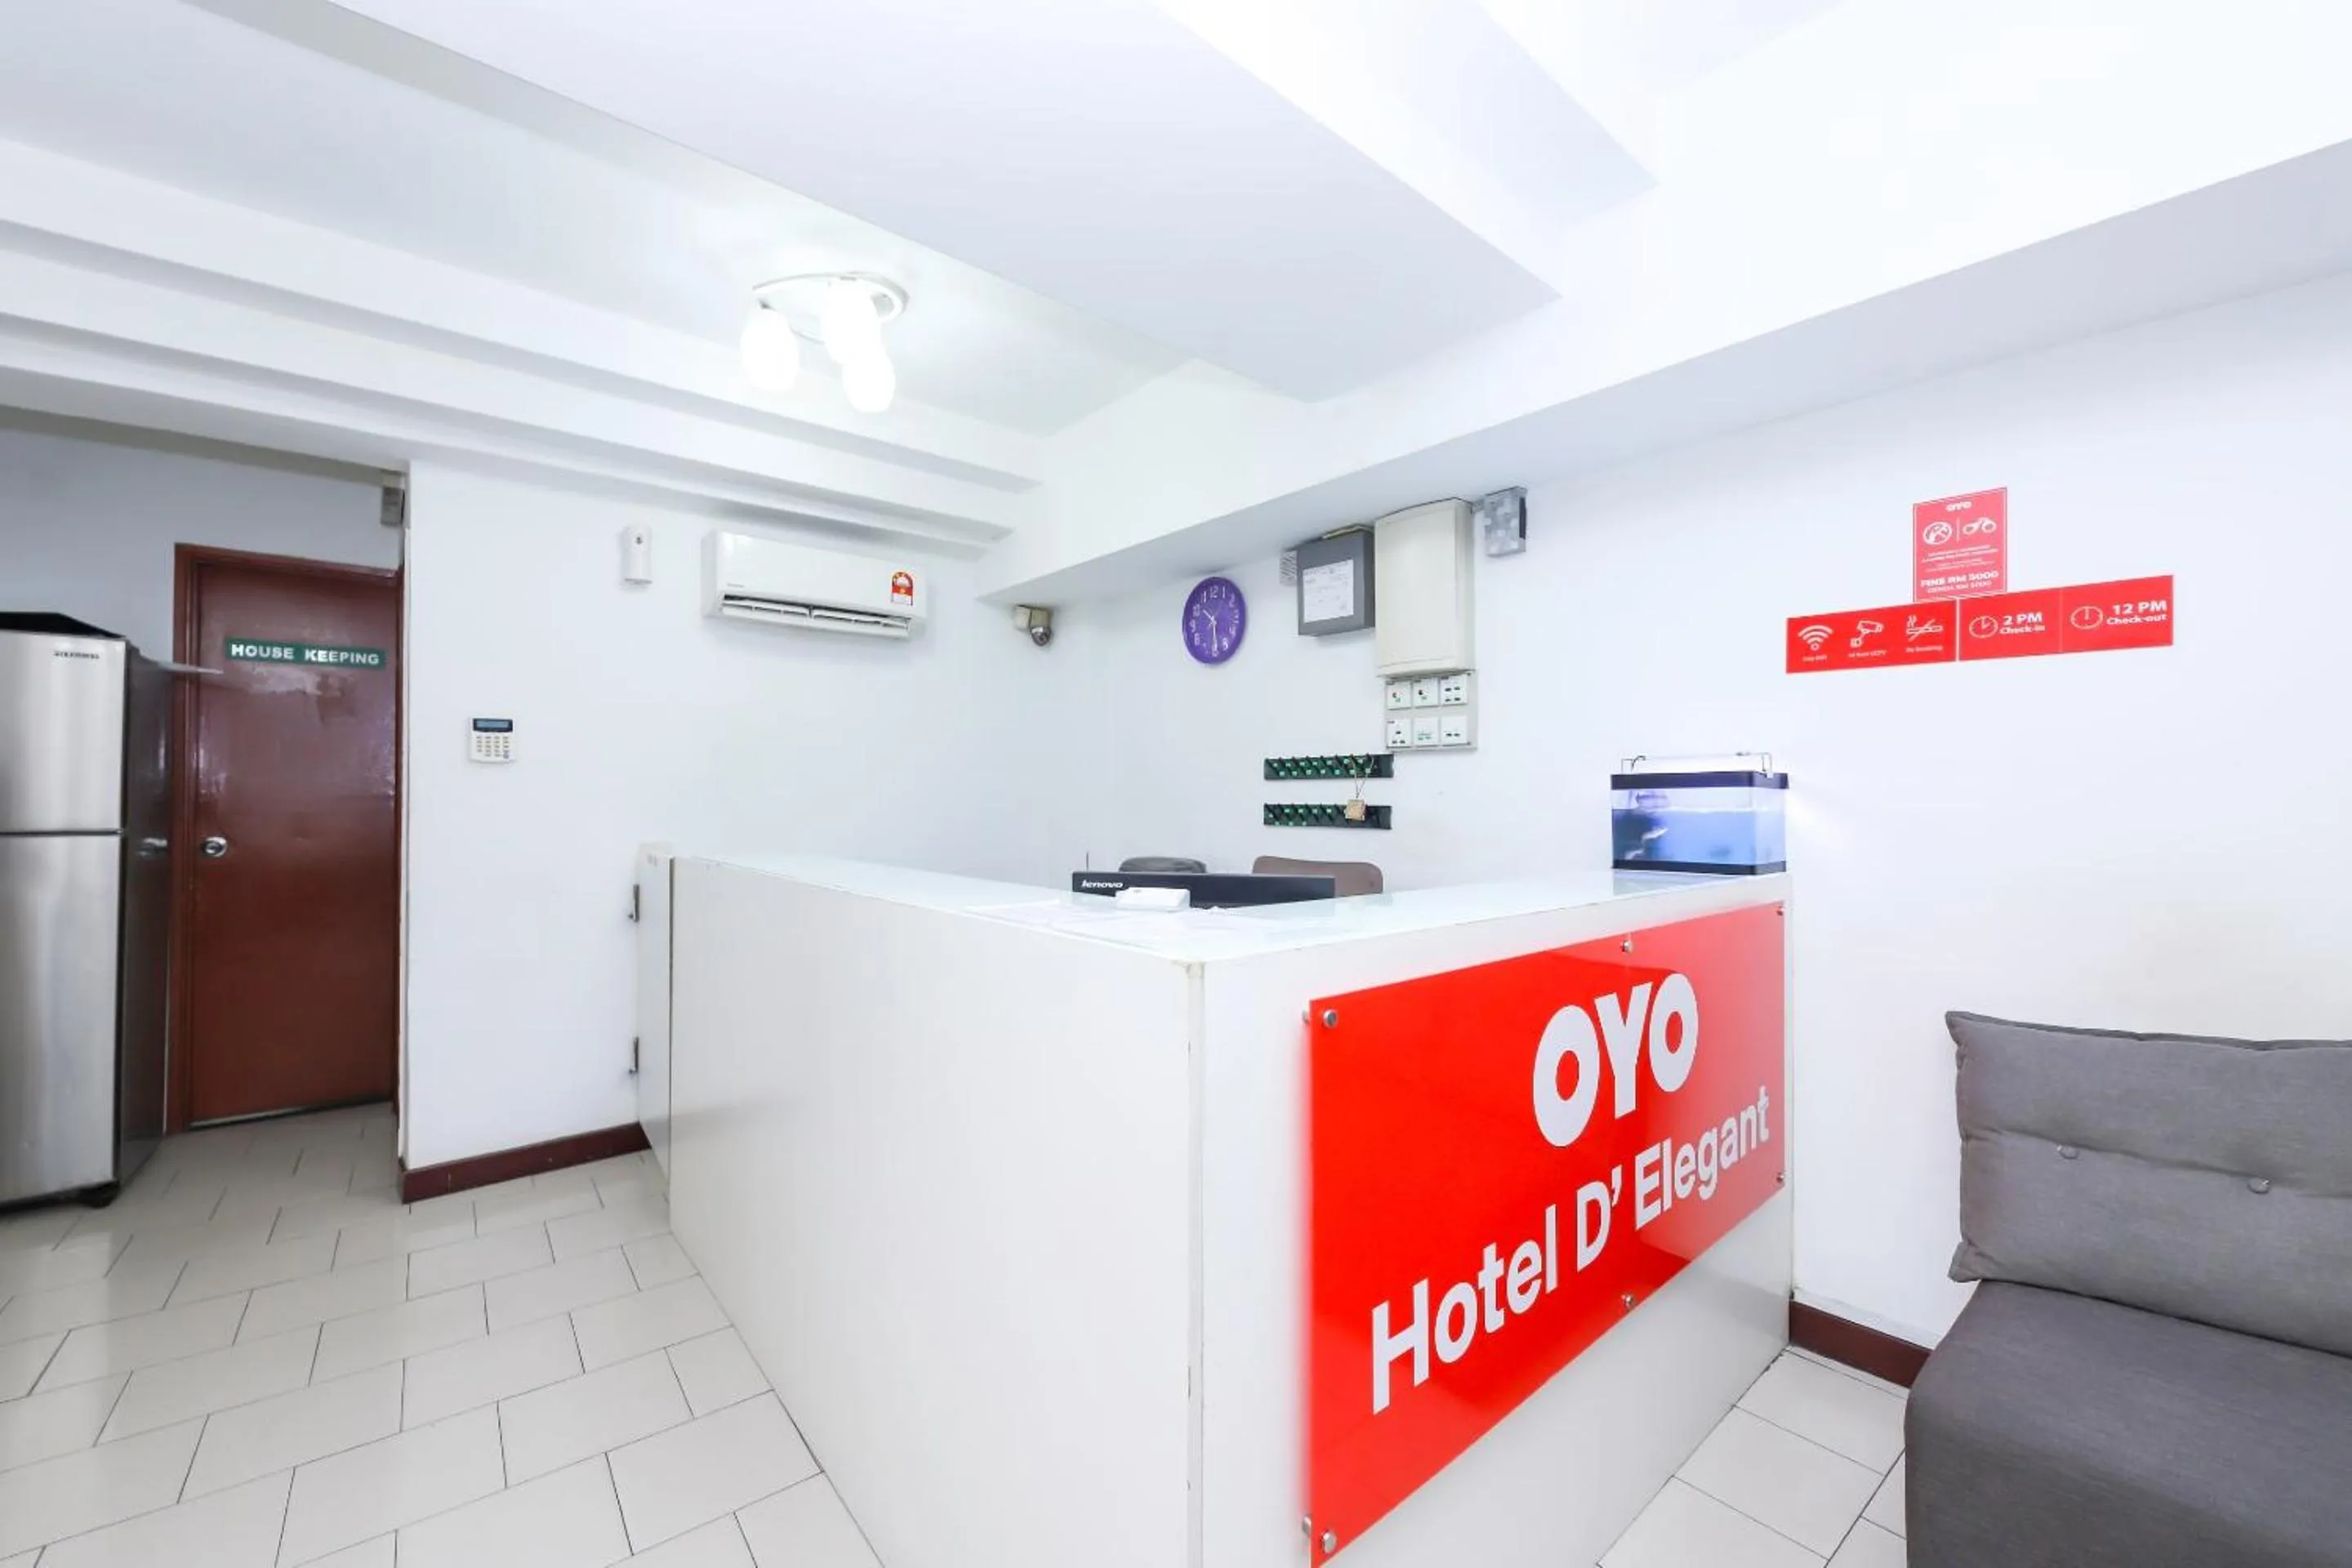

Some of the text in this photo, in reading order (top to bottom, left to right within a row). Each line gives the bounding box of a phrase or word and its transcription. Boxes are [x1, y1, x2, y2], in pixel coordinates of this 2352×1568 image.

[2111, 599, 2167, 615] 12 PM
[2002, 611, 2042, 626] 2 PM
[2106, 613, 2167, 625] Check-out
[1999, 624, 2046, 635] Check-in
[230, 643, 380, 666] HOUSE KEEPING
[1081, 879, 1124, 889] lenovo
[1533, 973, 1699, 1147] OYO
[1372, 1204, 1558, 1415] Hotel
[1635, 1085, 1771, 1231] Elegant
